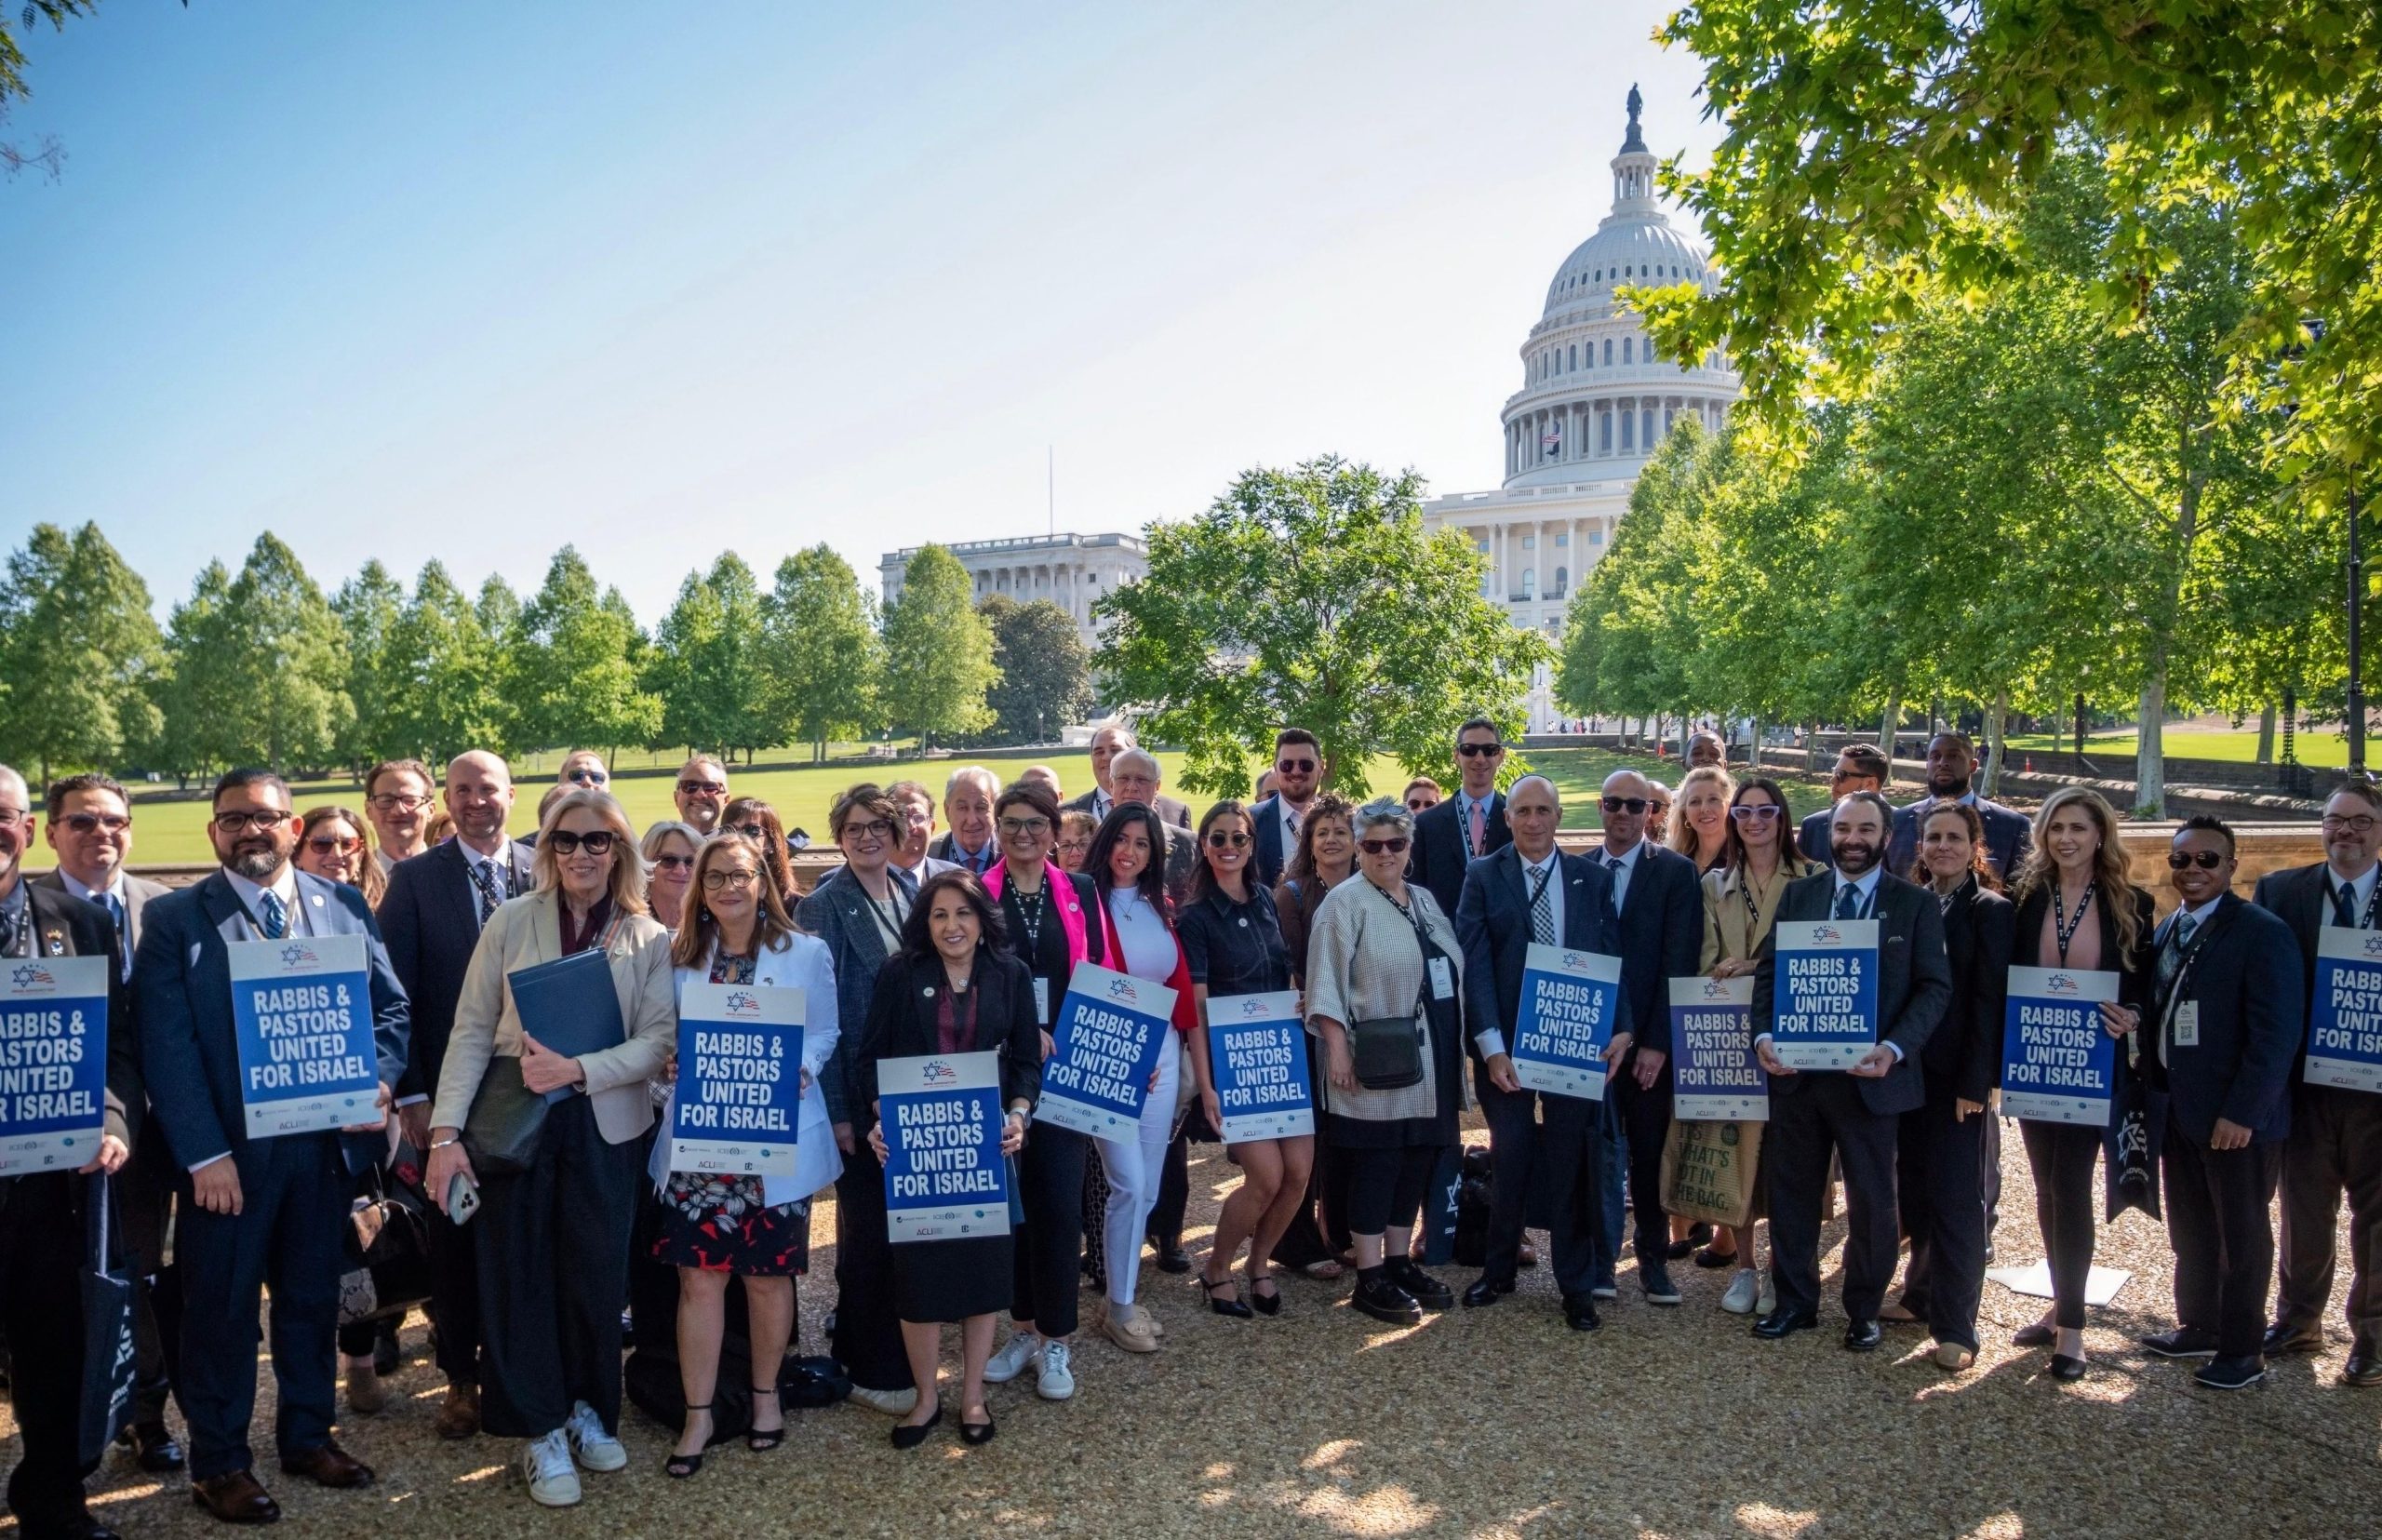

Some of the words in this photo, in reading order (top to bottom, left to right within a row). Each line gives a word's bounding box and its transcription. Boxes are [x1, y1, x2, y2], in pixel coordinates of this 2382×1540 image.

[1789, 957, 1844, 975] RABBIS
[1850, 957, 1861, 975] &
[1790, 977, 1859, 994] PASTORS
[2332, 969, 2382, 991] RABB
[254, 985, 329, 1013] RABBIS
[337, 984, 351, 1006] &
[1536, 980, 1588, 1004] RABBIS
[1593, 990, 1602, 1006] &
[1795, 996, 1853, 1013] UNITED
[2332, 989, 2382, 1012] PAST
[70, 1011, 86, 1035] &
[259, 1008, 351, 1038] PASTORS
[1535, 998, 1599, 1024] PASTORS
[1684, 1013, 1735, 1030] RABBIS
[1741, 1013, 1750, 1030] &
[2021, 1006, 2081, 1027] RABBIS
[2087, 1011, 2098, 1029] &
[2337, 1010, 2382, 1032] UNIT
[1074, 1005, 1133, 1038] RABBIS
[1136, 1024, 1147, 1043] &
[1539, 1017, 1591, 1041] UNITED
[1778, 1015, 1808, 1032] FOR
[1813, 1015, 1868, 1032] ISRAEL
[270, 1034, 346, 1062] UNITED
[695, 1032, 764, 1057] RABBIS
[770, 1036, 783, 1057] &
[1070, 1025, 1142, 1063] PASTORS
[1224, 1029, 1277, 1050] RABBIS
[1281, 1028, 1291, 1045] &
[1521, 1033, 1550, 1052] FOR
[1553, 1038, 1602, 1062] ISRAEL
[1687, 1032, 1750, 1049] PASTORS
[2021, 1025, 2095, 1049] PASTORS
[2315, 1028, 2352, 1050] FOR
[1071, 1047, 1130, 1080] UNITED
[1228, 1046, 1291, 1068] PASTORS
[1693, 1051, 1745, 1067] UNITED
[2027, 1046, 2088, 1066] UNITED
[0, 1065, 74, 1093] NITED
[250, 1064, 293, 1090] FOR
[298, 1056, 370, 1084] ISRAEL
[696, 1056, 780, 1081] PASTORS
[1236, 1065, 1289, 1087] UNITED
[1679, 1068, 1706, 1085] FOR
[1711, 1069, 1761, 1085] ISRAEL
[2008, 1064, 2041, 1083] FOR
[2045, 1066, 2104, 1089] ISRAEL
[703, 1081, 771, 1105] UNITED
[1047, 1063, 1081, 1089] FOR
[1083, 1073, 1137, 1106] ISRAEL
[1223, 1088, 1252, 1106] FOR
[1255, 1083, 1305, 1104] ISRAEL
[16, 1091, 96, 1120] ISRAEL
[681, 1104, 717, 1127] FOR
[724, 1106, 789, 1131] ISRAEL
[898, 1101, 964, 1126] RABBIS
[970, 1100, 984, 1121] &
[279, 1119, 298, 1130] ACLI
[1052, 1114, 1068, 1124] ACLI
[902, 1123, 984, 1149] PASTORS
[698, 1160, 715, 1169] ACLI
[910, 1147, 978, 1172] UNITED
[893, 1174, 930, 1197] FOR
[935, 1170, 999, 1194] ISRAEL
[1700, 1168, 1716, 1186] IN
[1697, 1188, 1729, 1211] BAG.
